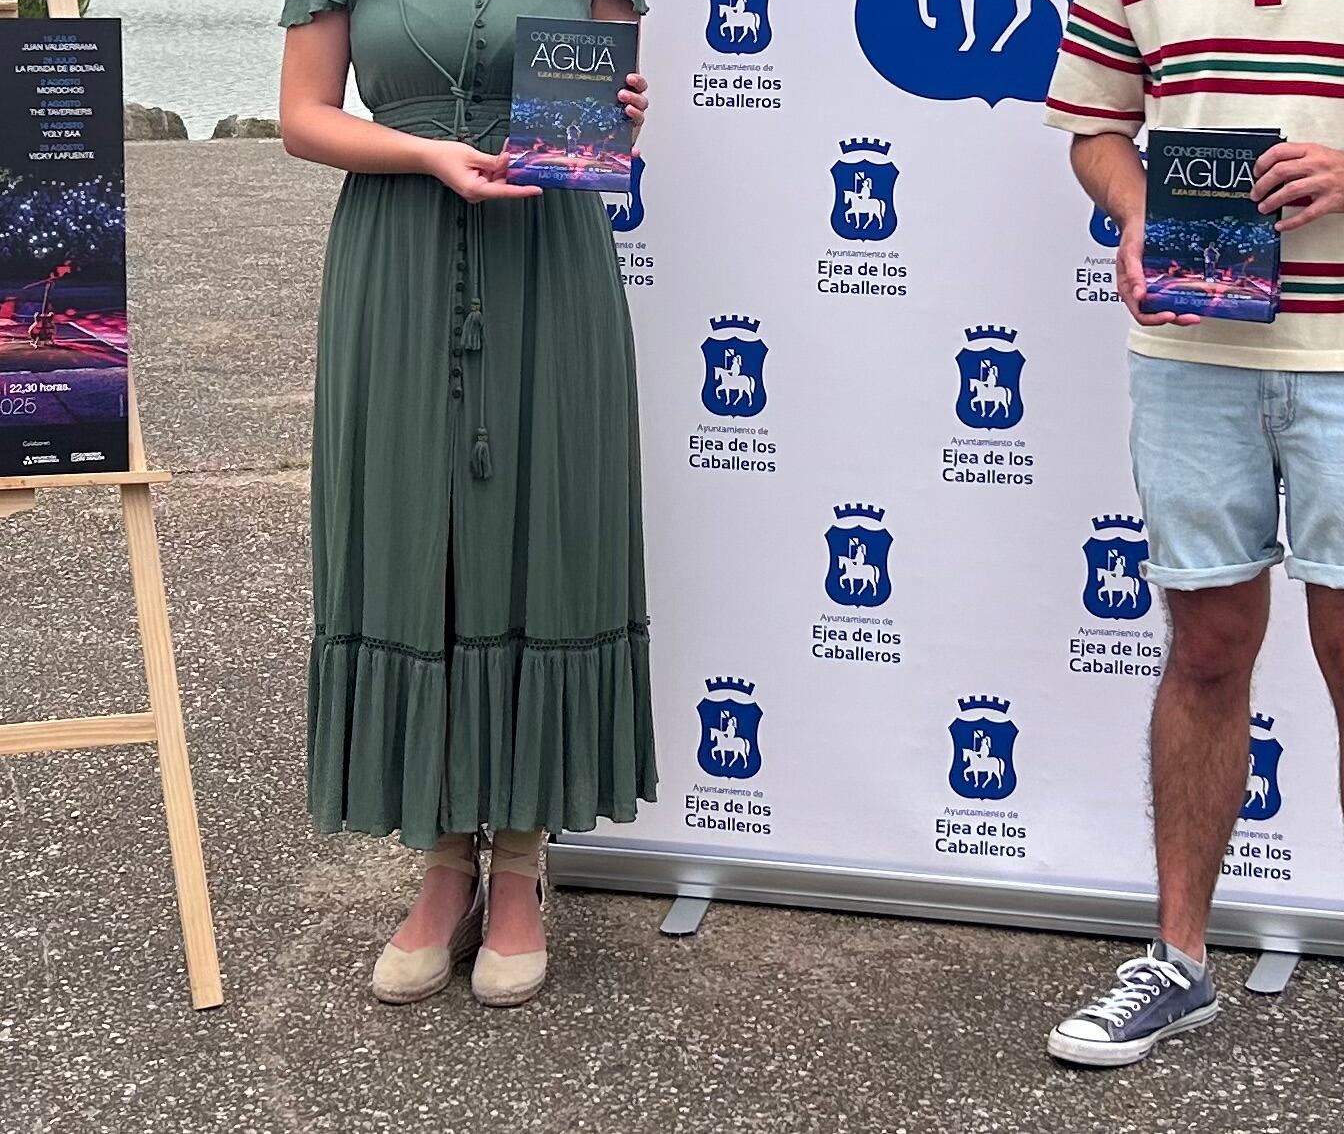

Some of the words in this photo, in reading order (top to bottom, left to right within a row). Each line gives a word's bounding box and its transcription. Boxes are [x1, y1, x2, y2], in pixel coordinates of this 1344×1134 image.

[22, 43, 43, 51] JUAN
[44, 43, 98, 51] VALDERRAMA
[530, 31, 596, 45] CONCIERTOS
[597, 35, 616, 47] DEL
[530, 42, 616, 73] AGUA
[15, 65, 26, 73] LA
[56, 65, 68, 73] DE
[702, 62, 760, 71] Ayuntamiento
[36, 86, 85, 94] MOROCHOS
[694, 74, 727, 91] Ejea
[733, 76, 752, 89] de
[758, 76, 781, 90] los
[693, 93, 780, 108] Caballeros
[29, 108, 46, 116] THE
[41, 130, 63, 138] YOLY
[64, 130, 81, 138] SAA
[28, 152, 53, 160] VICKY
[53, 151, 95, 160] LAFUENTE
[1163, 145, 1235, 159] CONCIERTOS
[1235, 148, 1256, 160] DEL
[1163, 157, 1255, 189] AGUA
[630, 253, 654, 267] los
[826, 249, 886, 258] Ayuntamiento
[818, 261, 852, 278] Ejea
[858, 262, 878, 276] de
[883, 263, 906, 277] los
[1076, 269, 1112, 285] Ejea
[818, 279, 906, 296] Caballeros
[697, 424, 756, 434] Ayuntamiento
[690, 436, 723, 453] Ejea
[729, 438, 748, 452] de
[753, 439, 776, 453] los
[951, 437, 1012, 446] Ayuntamiento
[689, 454, 775, 472] Caballeros
[943, 449, 978, 467] Ejea
[984, 451, 1004, 465] de
[1009, 452, 1033, 466] los
[943, 468, 1032, 484] Caballeros
[820, 614, 880, 624] Ayuntamiento
[882, 618, 893, 626] de
[813, 625, 847, 643] Ejea
[852, 628, 872, 642] de
[878, 630, 900, 644] los
[1078, 627, 1140, 638] Ayuntamiento
[812, 644, 900, 663] Caballeros
[1070, 639, 1105, 656] Ejea
[1112, 642, 1132, 656] de
[1137, 642, 1161, 657] los
[1070, 658, 1162, 678] Caballeros
[693, 784, 751, 796] Ayuntamiento
[753, 790, 763, 798] de
[686, 795, 719, 813] Ejea
[724, 800, 743, 813] de
[748, 801, 771, 816] los
[944, 807, 1005, 818] Ayuntamiento
[686, 814, 770, 834] Caballeros
[936, 819, 971, 837] Ejea
[977, 822, 996, 836] de
[1002, 823, 1026, 838] los
[1272, 832, 1283, 840] de
[936, 838, 1025, 858] Caballeros
[1240, 843, 1261, 858] de
[1266, 845, 1292, 861] los
[1221, 862, 1291, 880] balleros
